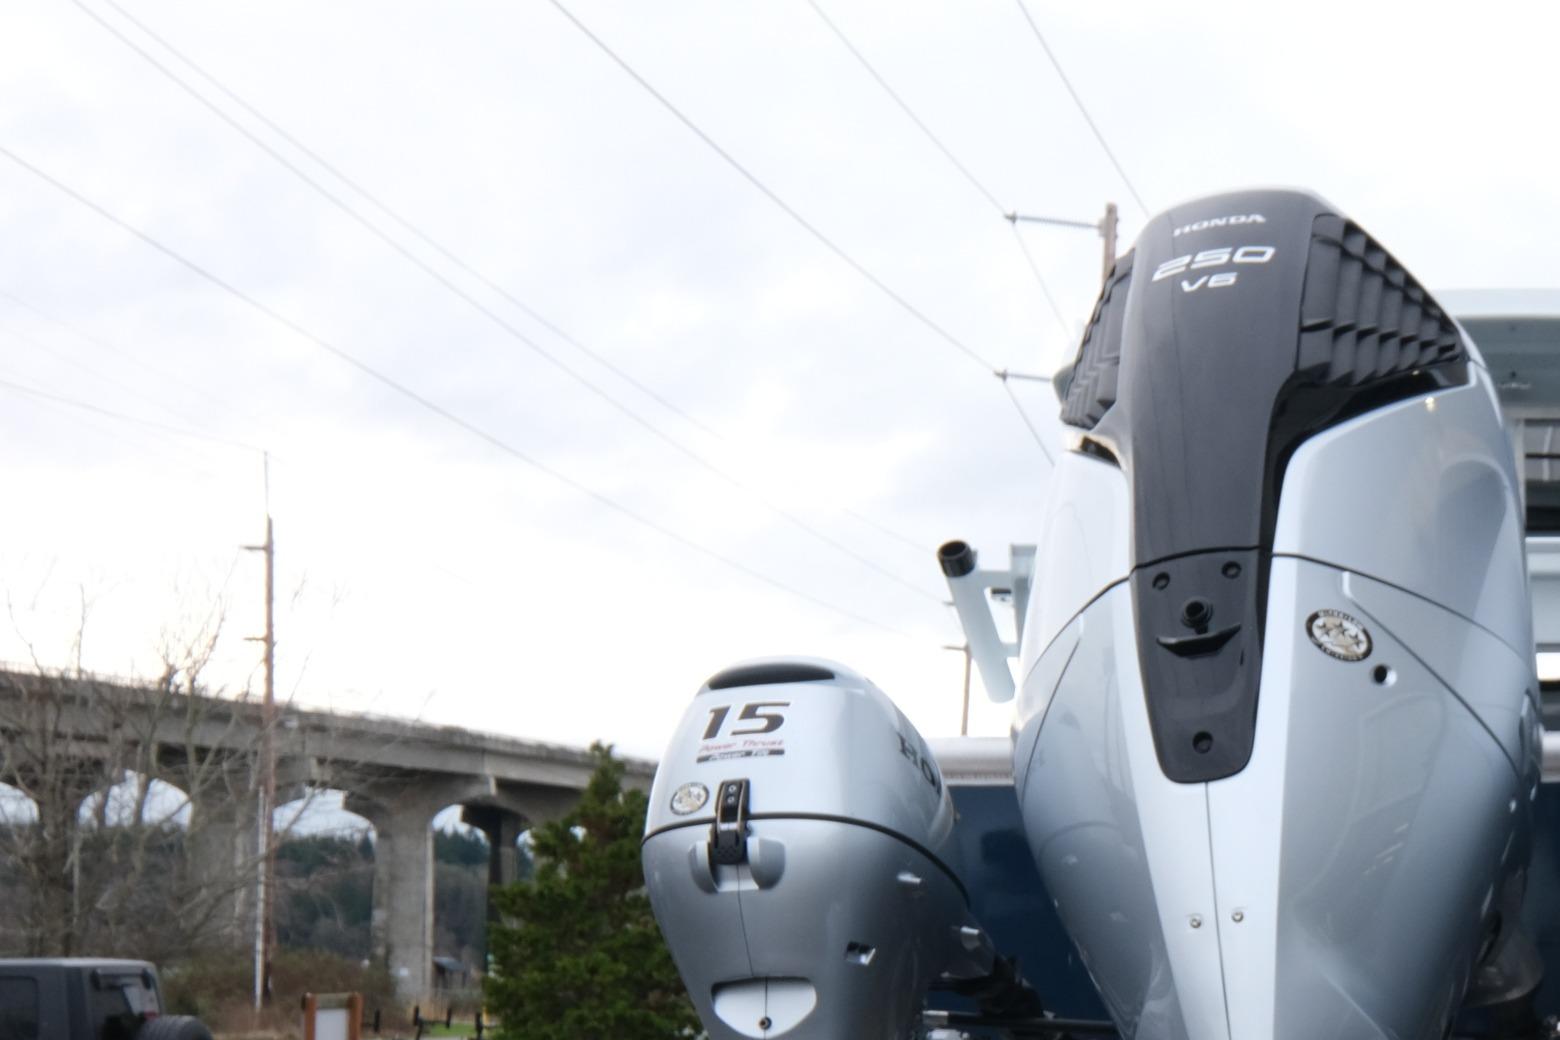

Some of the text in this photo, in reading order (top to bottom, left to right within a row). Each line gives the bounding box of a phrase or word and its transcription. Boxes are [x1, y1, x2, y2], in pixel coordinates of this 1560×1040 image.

[1172, 213, 1266, 237] HONDA
[1151, 245, 1276, 283] 250
[1180, 271, 1238, 292] V6
[702, 701, 791, 741] 15
